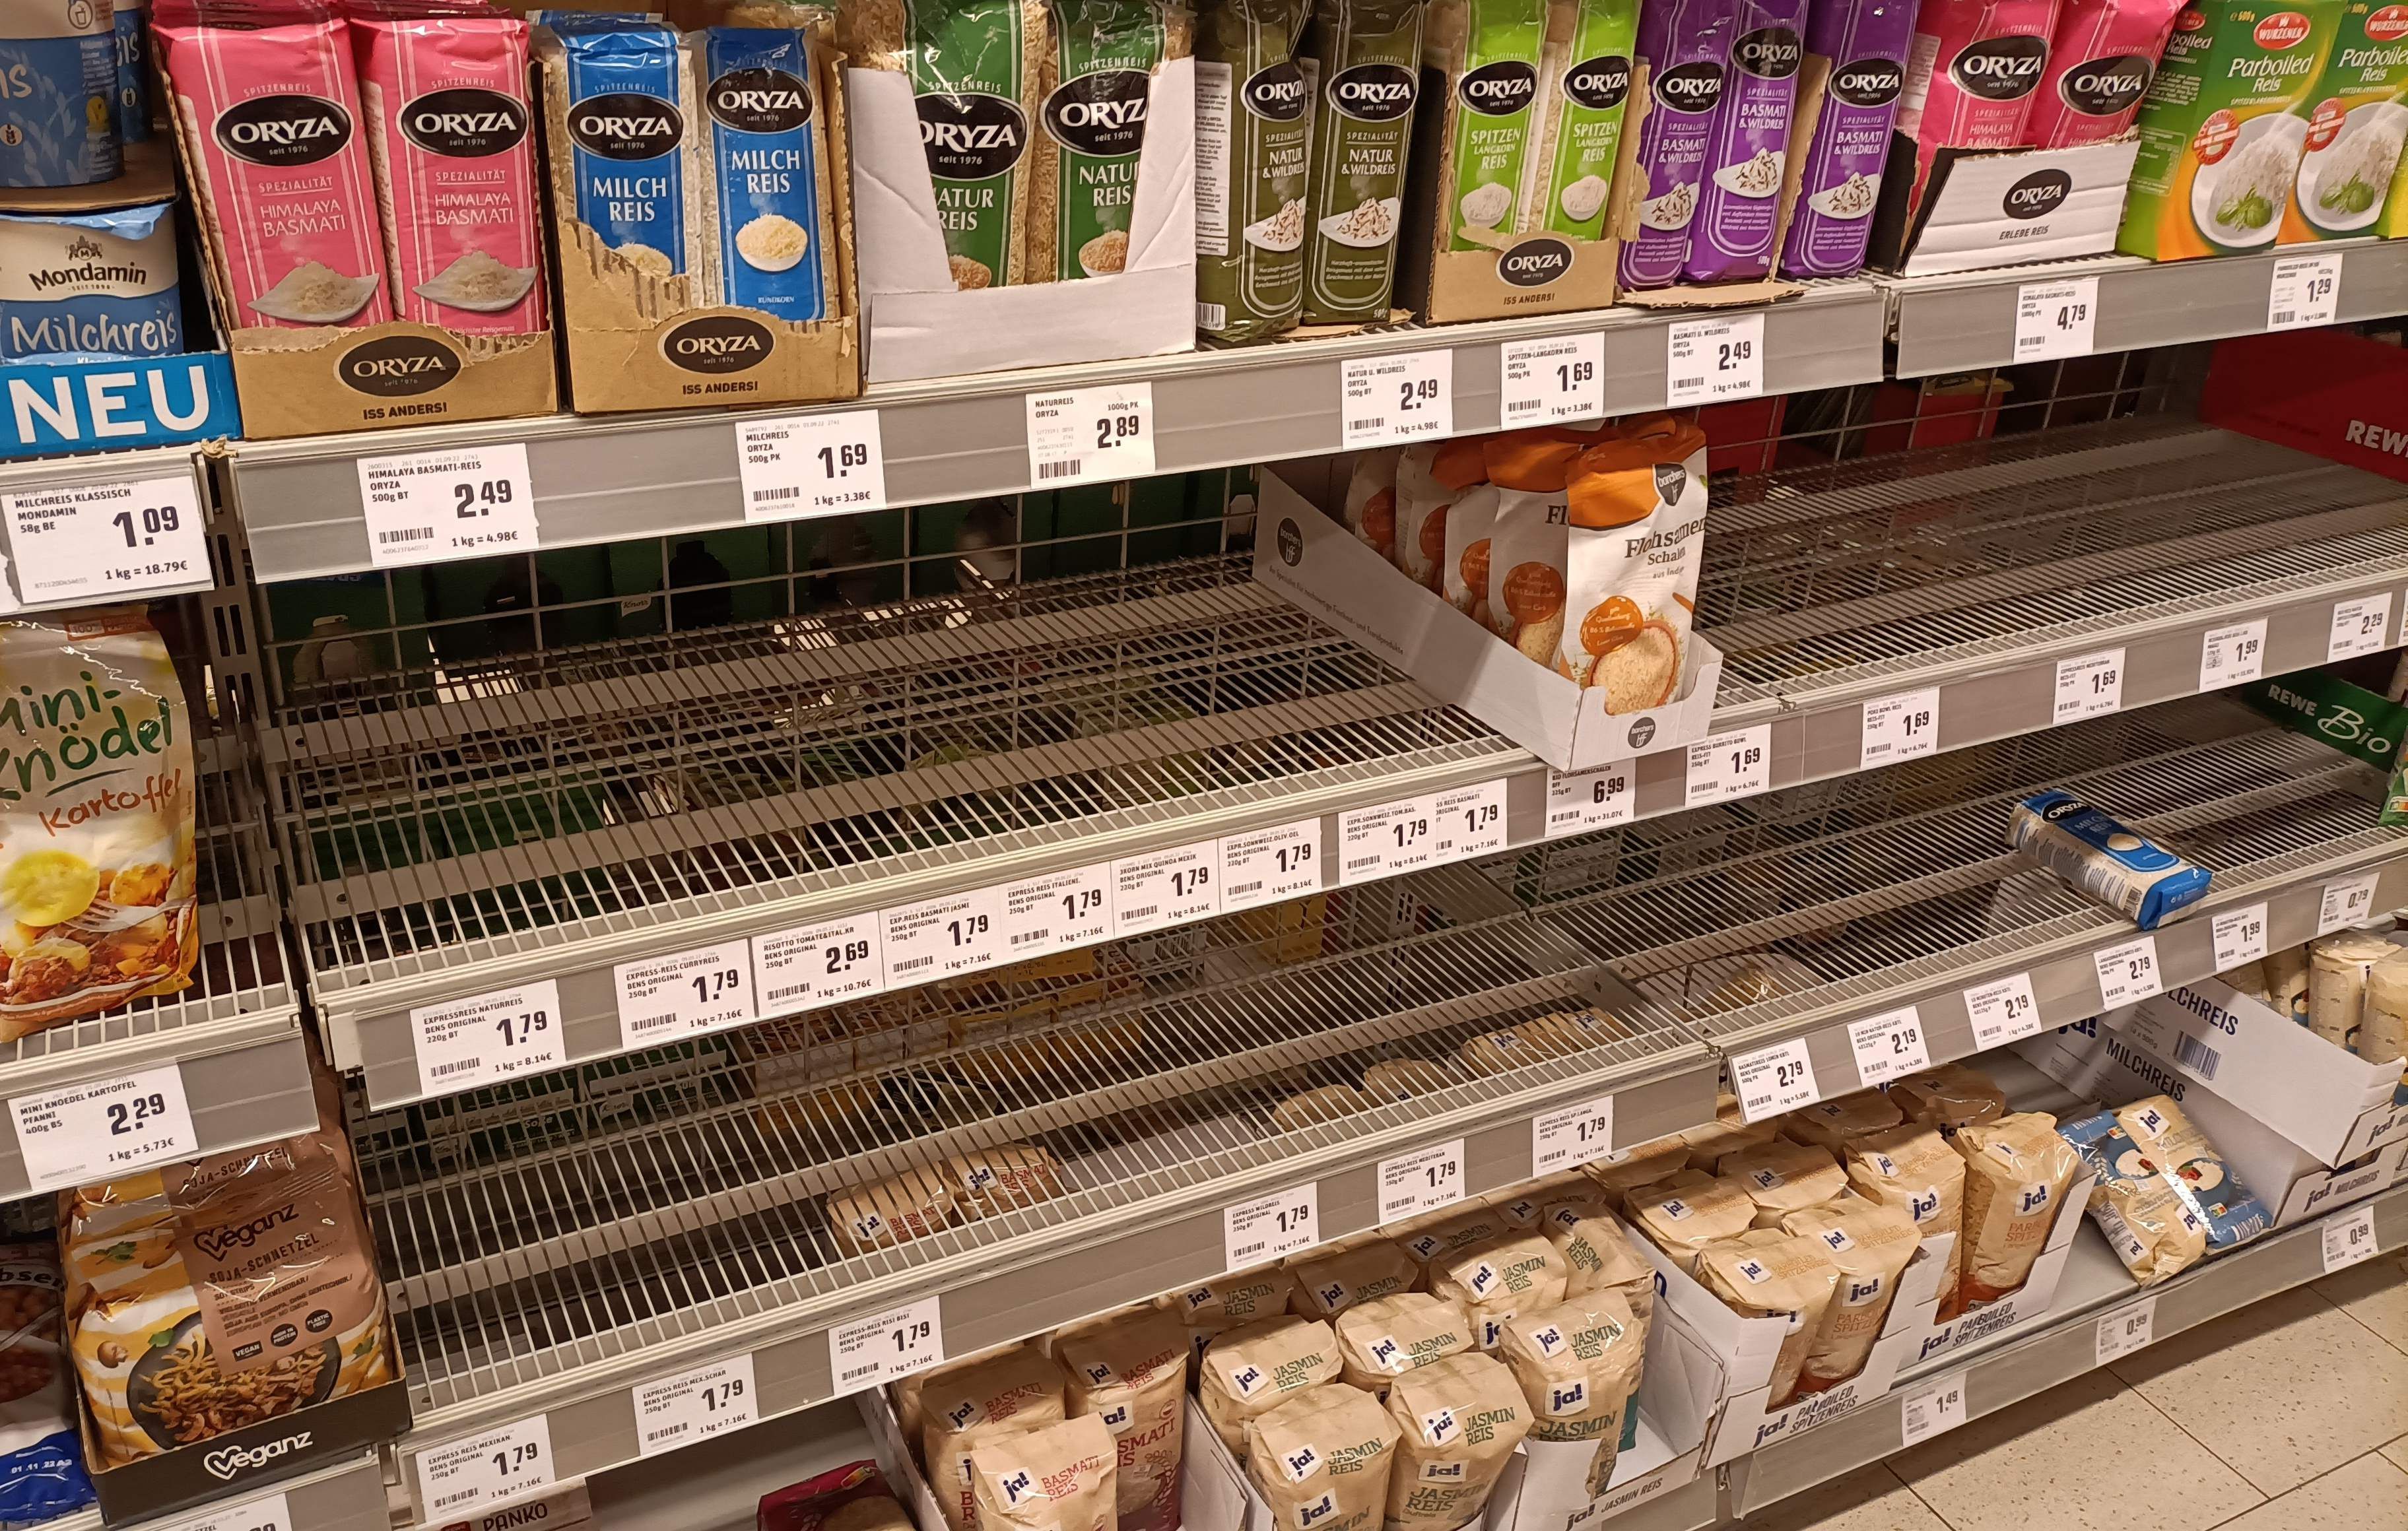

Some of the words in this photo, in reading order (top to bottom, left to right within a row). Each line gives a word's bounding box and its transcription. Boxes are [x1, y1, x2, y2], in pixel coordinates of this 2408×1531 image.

[2259, 26, 2304, 41] WURZENER
[1743, 42, 1798, 61] ORYZA
[1964, 55, 2041, 79] ORYZA
[2227, 55, 2313, 77] Parboiled
[1340, 83, 1410, 100] ORYZA
[1469, 78, 1531, 98] ORYZA
[1574, 72, 1628, 90] ORYZA
[1666, 78, 1721, 96] ORYZA
[1840, 73, 1900, 90] ORYZA
[2075, 73, 2143, 92] ORYZA
[2252, 77, 2281, 92] Reis
[718, 90, 804, 110] ORYZA
[1741, 104, 1786, 117] BASMATI
[231, 118, 339, 144] ORYZA
[415, 113, 516, 136] ORYZA
[580, 117, 672, 139] ORYZA
[1573, 122, 1617, 137] SPITZEN
[1471, 129, 1520, 144] SPITZEN
[1837, 132, 1883, 143] BASMATI
[731, 150, 800, 170] MILCH
[1269, 148, 1303, 164] NATUR
[1349, 149, 1393, 162] NATUR
[1482, 156, 1507, 169] REIS
[1582, 149, 1606, 162] REIS
[593, 178, 667, 197] MILCH
[747, 173, 790, 193] REIS
[2011, 183, 2063, 204] ORYZA
[435, 193, 510, 207] HIMALAYA
[1092, 186, 1131, 206] REIS
[260, 199, 341, 217] HIMALAYA
[436, 206, 514, 224] BASMATI
[609, 201, 655, 222] REIS
[263, 215, 345, 237] BASMATI
[1999, 227, 2029, 240] ERLEBE
[1507, 254, 1562, 271] ORYZA
[29, 263, 146, 291] Mondamin
[2307, 278, 2331, 302] 1.29
[2057, 305, 2086, 329] 4.79
[11, 311, 176, 353] Milchreis
[677, 334, 760, 353] ORYZA
[353, 356, 446, 377] ORYZA
[1719, 341, 1751, 370] 2.49
[1556, 363, 1593, 392] 1.69
[8, 366, 209, 443] NEU
[1035, 397, 1074, 407] NATURREIS
[1400, 379, 1438, 410] 2.49
[363, 407, 385, 420] ISS
[1036, 409, 1059, 418] ORYZA
[746, 432, 789, 441] MILCHREIS
[1096, 416, 1139, 449] 2.89
[748, 443, 773, 453] ORYZA
[368, 469, 415, 478] HIMALAYA
[417, 461, 482, 474] BASMATI-REIS
[818, 444, 867, 479] 1.69
[370, 480, 400, 490] ORYZA
[1656, 467, 1685, 490] borchers
[15, 496, 72, 508] MILCHREIS
[75, 488, 131, 503] KLASSISCH
[372, 492, 395, 502] 500g
[455, 480, 512, 519] 2.49
[17, 507, 77, 521] MONDAMIN
[20, 523, 40, 534] 58g
[113, 506, 180, 547] 1.09
[486, 531, 518, 542] 4.98€
[1624, 519, 1706, 558] Flohsamen
[145, 560, 188, 575] 18.79€
[2362, 612, 2384, 635] 2.29
[2236, 638, 2258, 662] 1.99
[2091, 669, 2117, 694] 1.69
[2269, 684, 2317, 718] REWE
[1903, 711, 1929, 736] 1.69
[2318, 705, 2391, 754] Bio
[1731, 748, 1760, 774] 1.69
[1593, 777, 1624, 803] 6.99
[39, 769, 182, 837] Kartoffel
[1465, 805, 1498, 833] 1.79
[1393, 819, 1428, 847] 1.79
[1275, 844, 1312, 872] 1.79
[1170, 867, 1209, 897] 1.79
[1062, 890, 1102, 920] 1.79
[2347, 890, 2368, 908] 0.79
[947, 915, 989, 947] 1.79
[2241, 922, 2260, 942] 1.99
[763, 940, 793, 952] RISOTTO
[826, 940, 869, 974] 2.69
[626, 966, 677, 981] EXPRESS-REIS
[679, 956, 719, 971] CURRYREIS
[2129, 957, 2151, 980] 2.79
[627, 981, 646, 990] BENS
[648, 973, 683, 986] ORIGINAL
[692, 969, 739, 1004] 1.79
[424, 1008, 477, 1025] EXPRESSREIS
[479, 997, 523, 1013] NATURREIS
[2005, 994, 2029, 1020] 2.19
[426, 1024, 445, 1034] BENS
[448, 1015, 486, 1029] ORIGINAL
[496, 1010, 548, 1047] 1.79
[426, 1032, 446, 1043] 220g
[1891, 1029, 1917, 1055] 2.19
[1778, 1061, 1804, 1088] 2.79
[2106, 1038, 2186, 1102] MILCHREIS
[20, 1105, 43, 1116] MINI
[45, 1093, 85, 1109] KNOEDEL
[88, 1081, 137, 1098] KARTOFFEL
[23, 1111, 56, 1125] PFANNI
[107, 1093, 165, 1136] 2.29
[2139, 1109, 2161, 1132] ja!
[26, 1124, 48, 1134] 400g
[1577, 1117, 1606, 1142] 1.79
[143, 1137, 175, 1154] 5.73€
[1426, 1161, 1456, 1188] 1.79
[2023, 1185, 2047, 1212] ja!
[1276, 1205, 1308, 1233] 1.79
[2349, 1224, 2368, 1245] 0.99
[209, 1233, 320, 1284] SOJA-SCHNETZEL
[1503, 1256, 1547, 1282] JASMIN
[1471, 1267, 1492, 1292] ja!
[1508, 1275, 1533, 1292] REIS
[1850, 1279, 1879, 1301] ja!
[1187, 1288, 1212, 1309] ja!
[1223, 1284, 1275, 1306] JASMIN
[1224, 1301, 1255, 1315] REIS
[839, 1322, 881, 1340] EXPRESS-REIS
[892, 1322, 930, 1352] 1.79
[1536, 1328, 1560, 1352] ja!
[1953, 1311, 2017, 1348] SPITZENREIS
[234, 1345, 261, 1359] VEGAN
[1087, 1365, 1109, 1384] ja!
[1273, 1353, 1324, 1381] JASMIN
[1234, 1367, 1260, 1393] ja!
[643, 1388, 672, 1400] EXPRESS
[701, 1379, 743, 1412] 1.79
[985, 1383, 1043, 1410] BASMATI
[1553, 1384, 1582, 1410] ja!
[1936, 1391, 1958, 1414] 1.49
[948, 1402, 975, 1429] ja!
[990, 1405, 1018, 1424] REIS
[1464, 1408, 1516, 1432] JASMIN
[1539, 1411, 1618, 1436] JASMIN
[1466, 1426, 1494, 1445] REIS
[428, 1449, 459, 1465] EXPRESS
[492, 1443, 538, 1476] 1.79
[1328, 1437, 1383, 1464] JASMIN
[1042, 1456, 1099, 1489] BASMATI
[1329, 1459, 1363, 1474] REIS
[1428, 1463, 1460, 1478] ja!
[1300, 1496, 1331, 1520] ja!
[1406, 1496, 1455, 1513] REIS
[483, 1503, 548, 1531] PANKO
